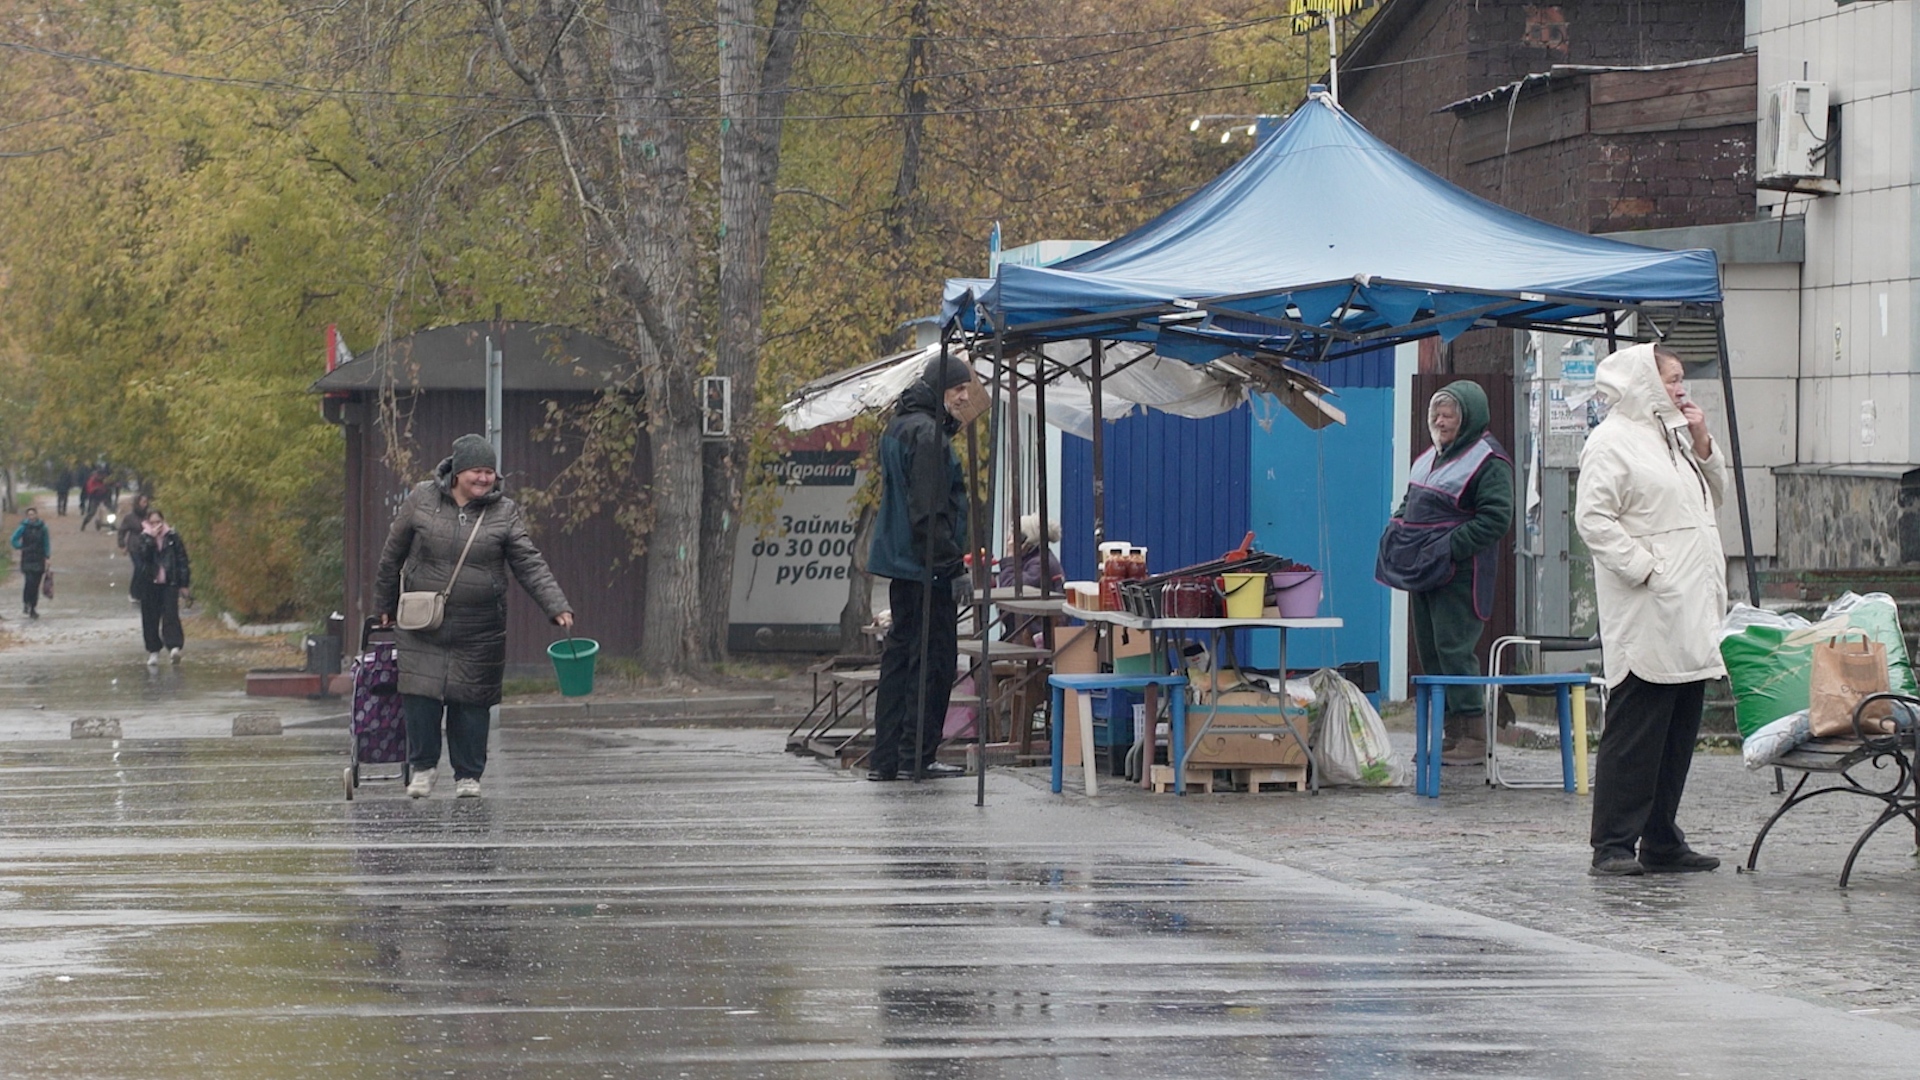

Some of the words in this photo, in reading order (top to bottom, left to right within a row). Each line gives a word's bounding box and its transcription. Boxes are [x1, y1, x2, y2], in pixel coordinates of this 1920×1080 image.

[751, 537, 780, 557] до
[784, 538, 813, 557] 30
[775, 560, 850, 585] рубле
